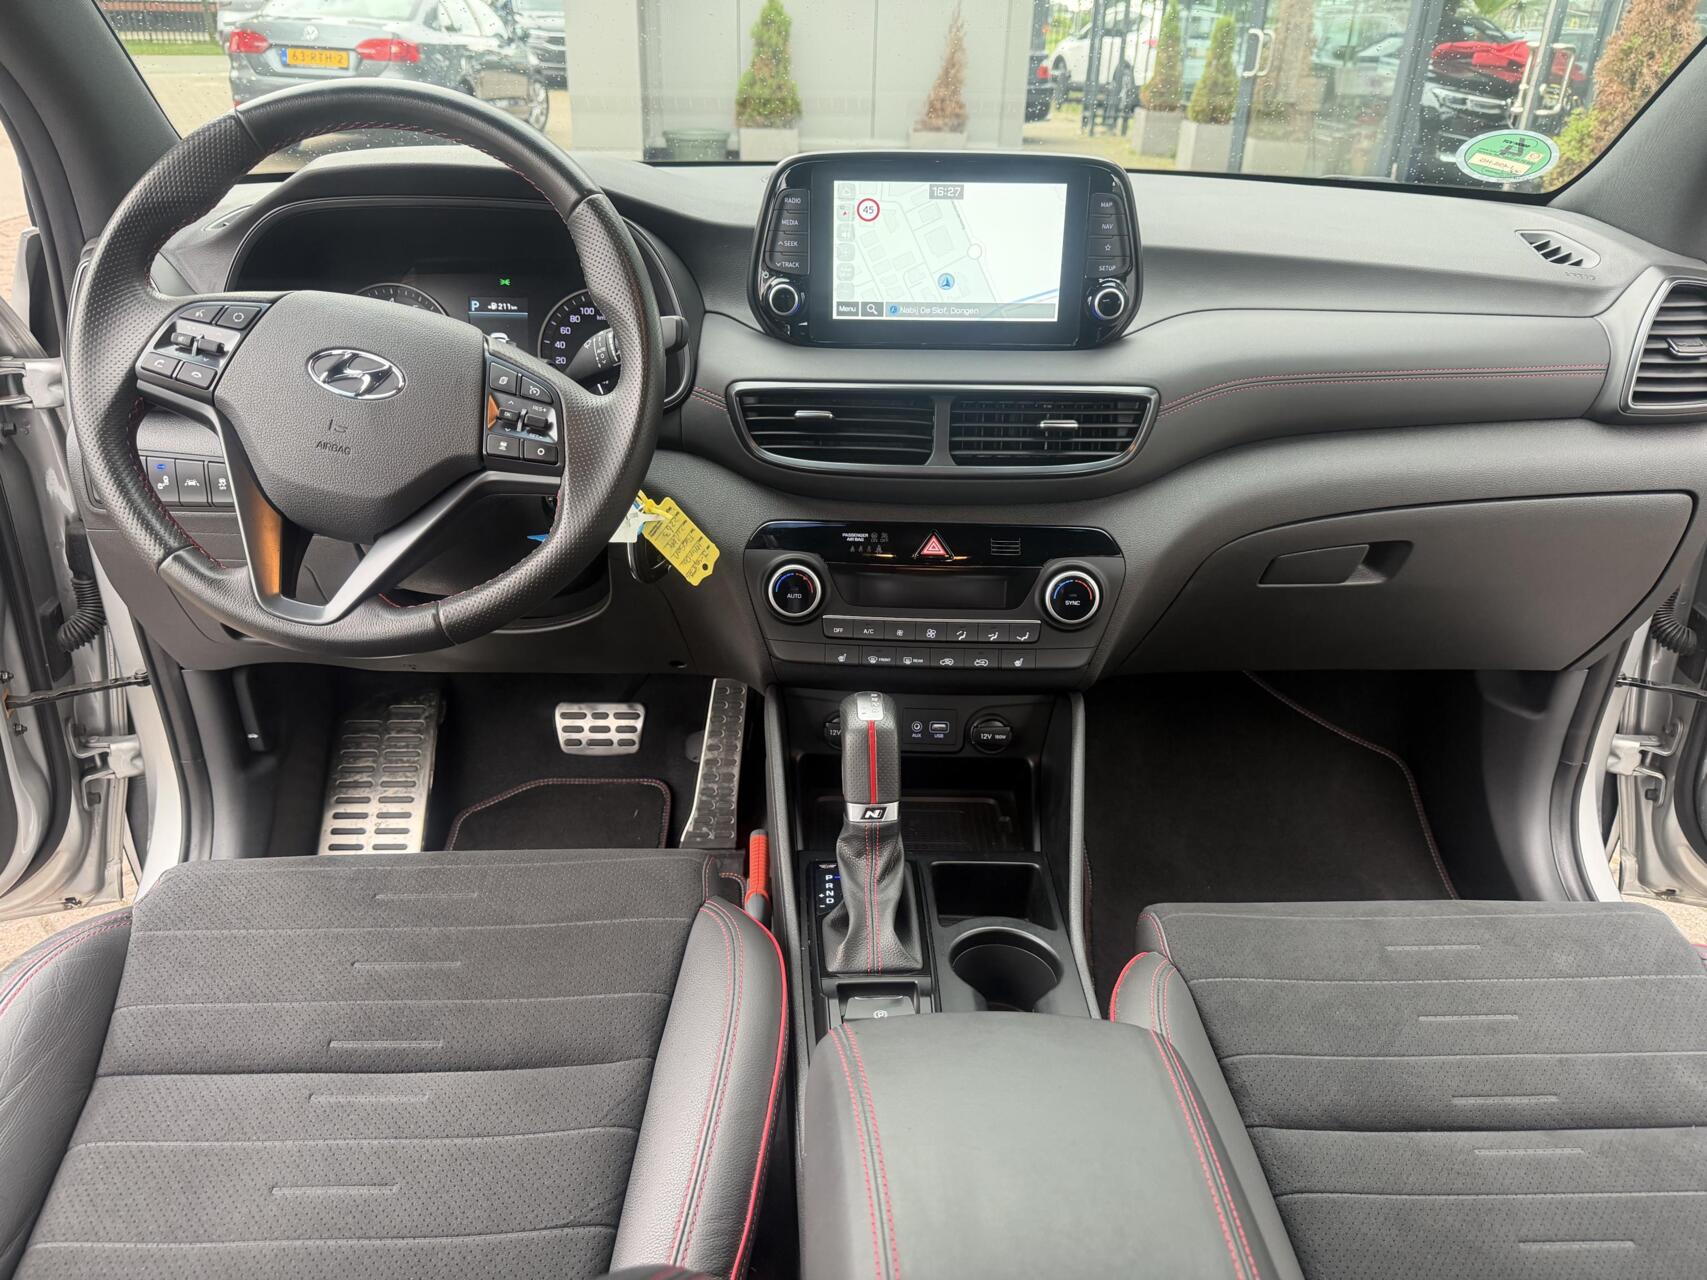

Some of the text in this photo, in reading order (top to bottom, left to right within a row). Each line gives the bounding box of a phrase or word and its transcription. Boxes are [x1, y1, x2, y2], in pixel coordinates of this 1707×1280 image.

[932, 187, 960, 197] 16:27
[862, 205, 874, 214] 45
[471, 300, 480, 311] P
[839, 305, 857, 313] Menu
[580, 307, 595, 315] 100
[569, 315, 581, 323] 80
[560, 327, 571, 335] 60
[554, 341, 566, 349] 40
[555, 357, 567, 365] 20
[315, 440, 351, 456] AIRBAG
